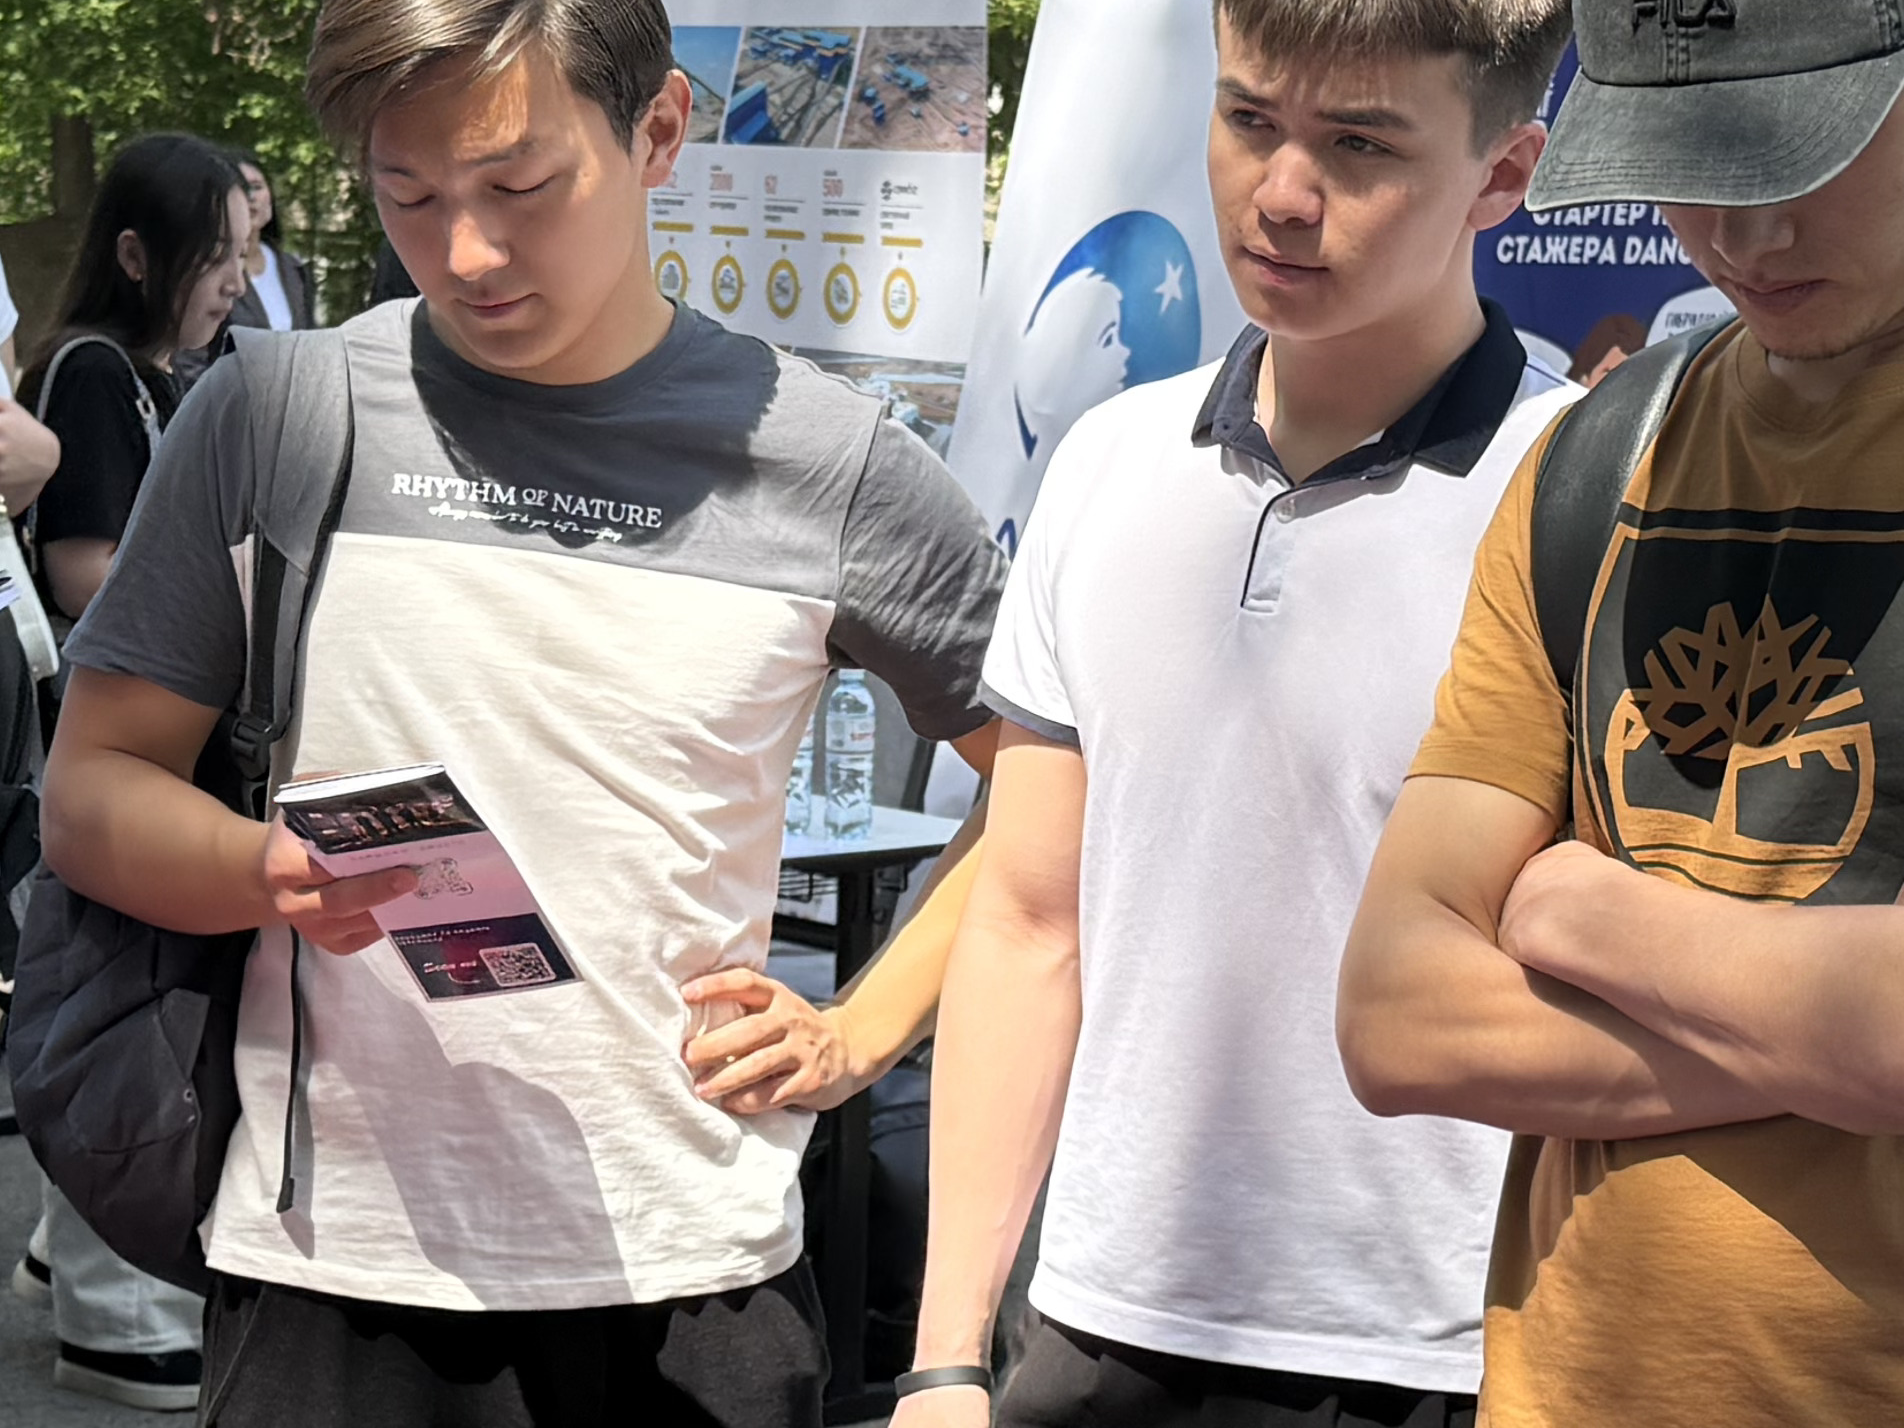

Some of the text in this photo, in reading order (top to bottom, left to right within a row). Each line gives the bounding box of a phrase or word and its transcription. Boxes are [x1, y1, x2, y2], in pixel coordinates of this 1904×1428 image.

[1496, 235, 1616, 265] СТАЖЕРА
[391, 473, 517, 506] RHYTHM
[522, 488, 548, 507] OF
[551, 492, 663, 528] NATURE
